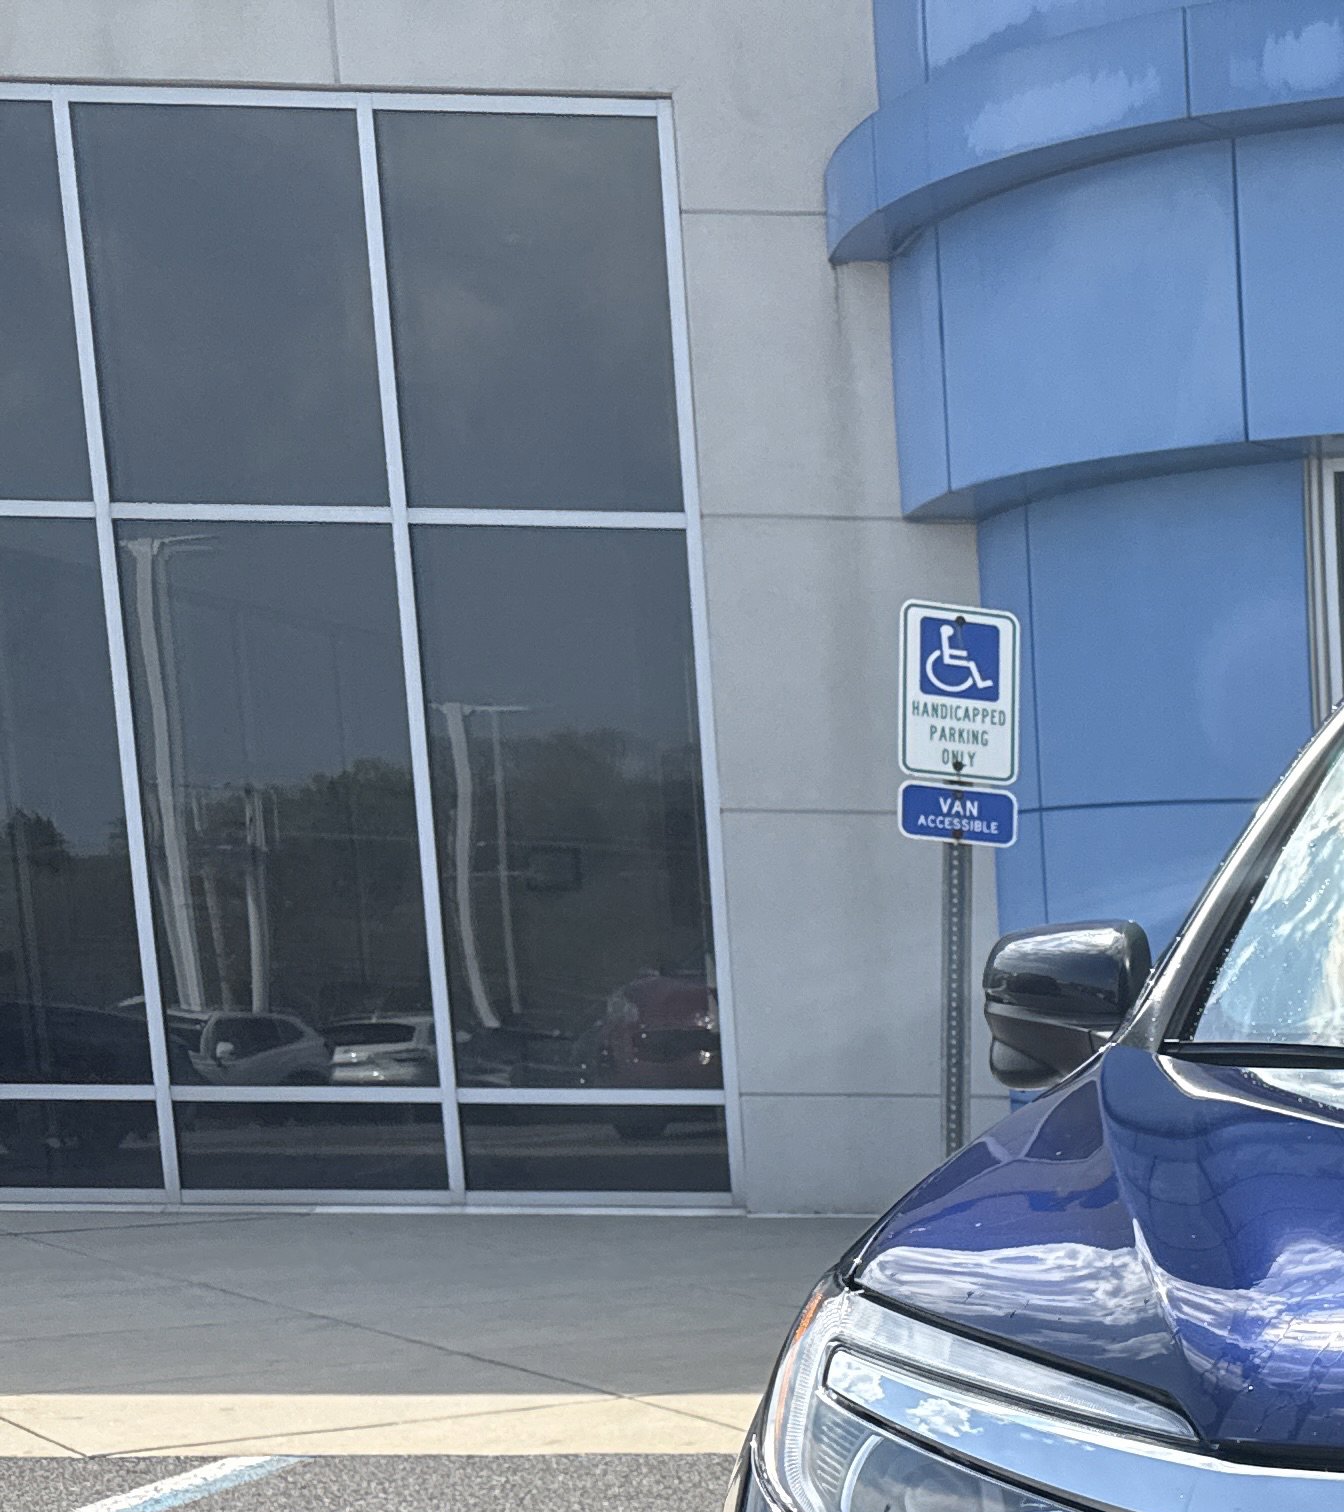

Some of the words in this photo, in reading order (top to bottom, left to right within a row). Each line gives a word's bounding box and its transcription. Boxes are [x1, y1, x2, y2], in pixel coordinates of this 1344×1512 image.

[912, 701, 1006, 726] HANDICAPPED
[929, 725, 989, 746] PARKING
[939, 796, 979, 817] VAN
[917, 815, 999, 834] ACCESSIBLE
